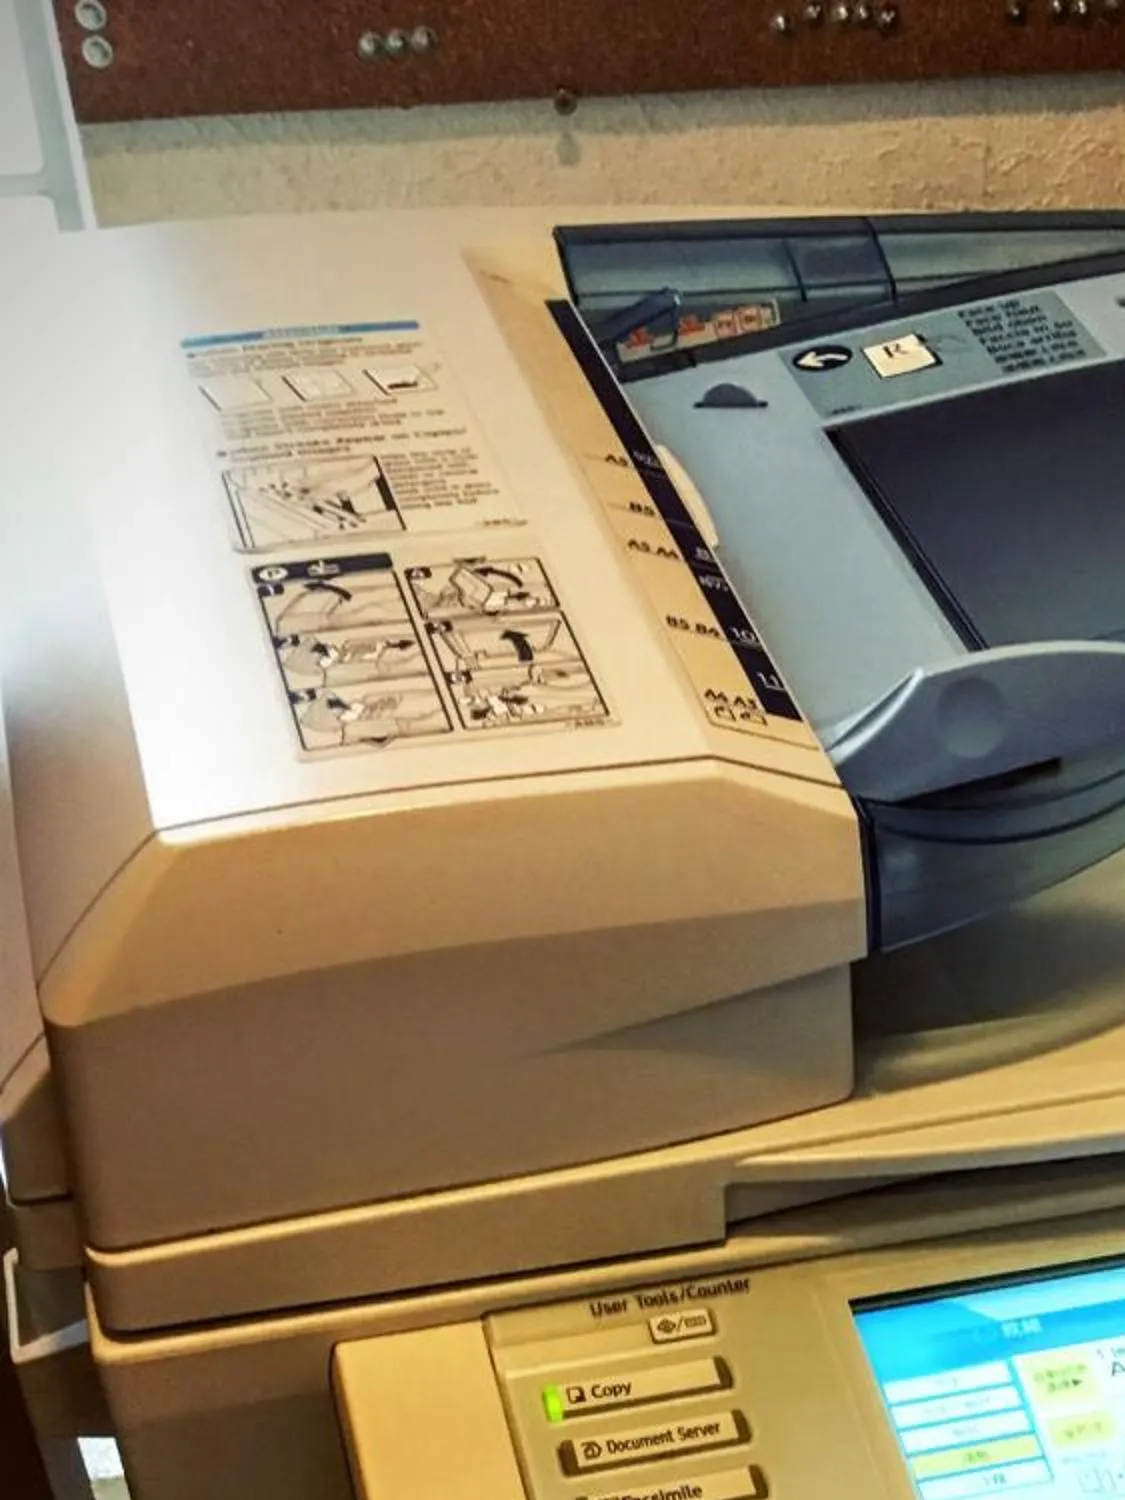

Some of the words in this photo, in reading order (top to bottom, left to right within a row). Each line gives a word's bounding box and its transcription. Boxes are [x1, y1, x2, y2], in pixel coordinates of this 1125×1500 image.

[589, 1299, 628, 1318] User
[637, 1278, 751, 1310] Tools/Counter
[591, 1382, 632, 1399] Copy
[606, 1429, 675, 1455] Document
[677, 1421, 721, 1442] Server
